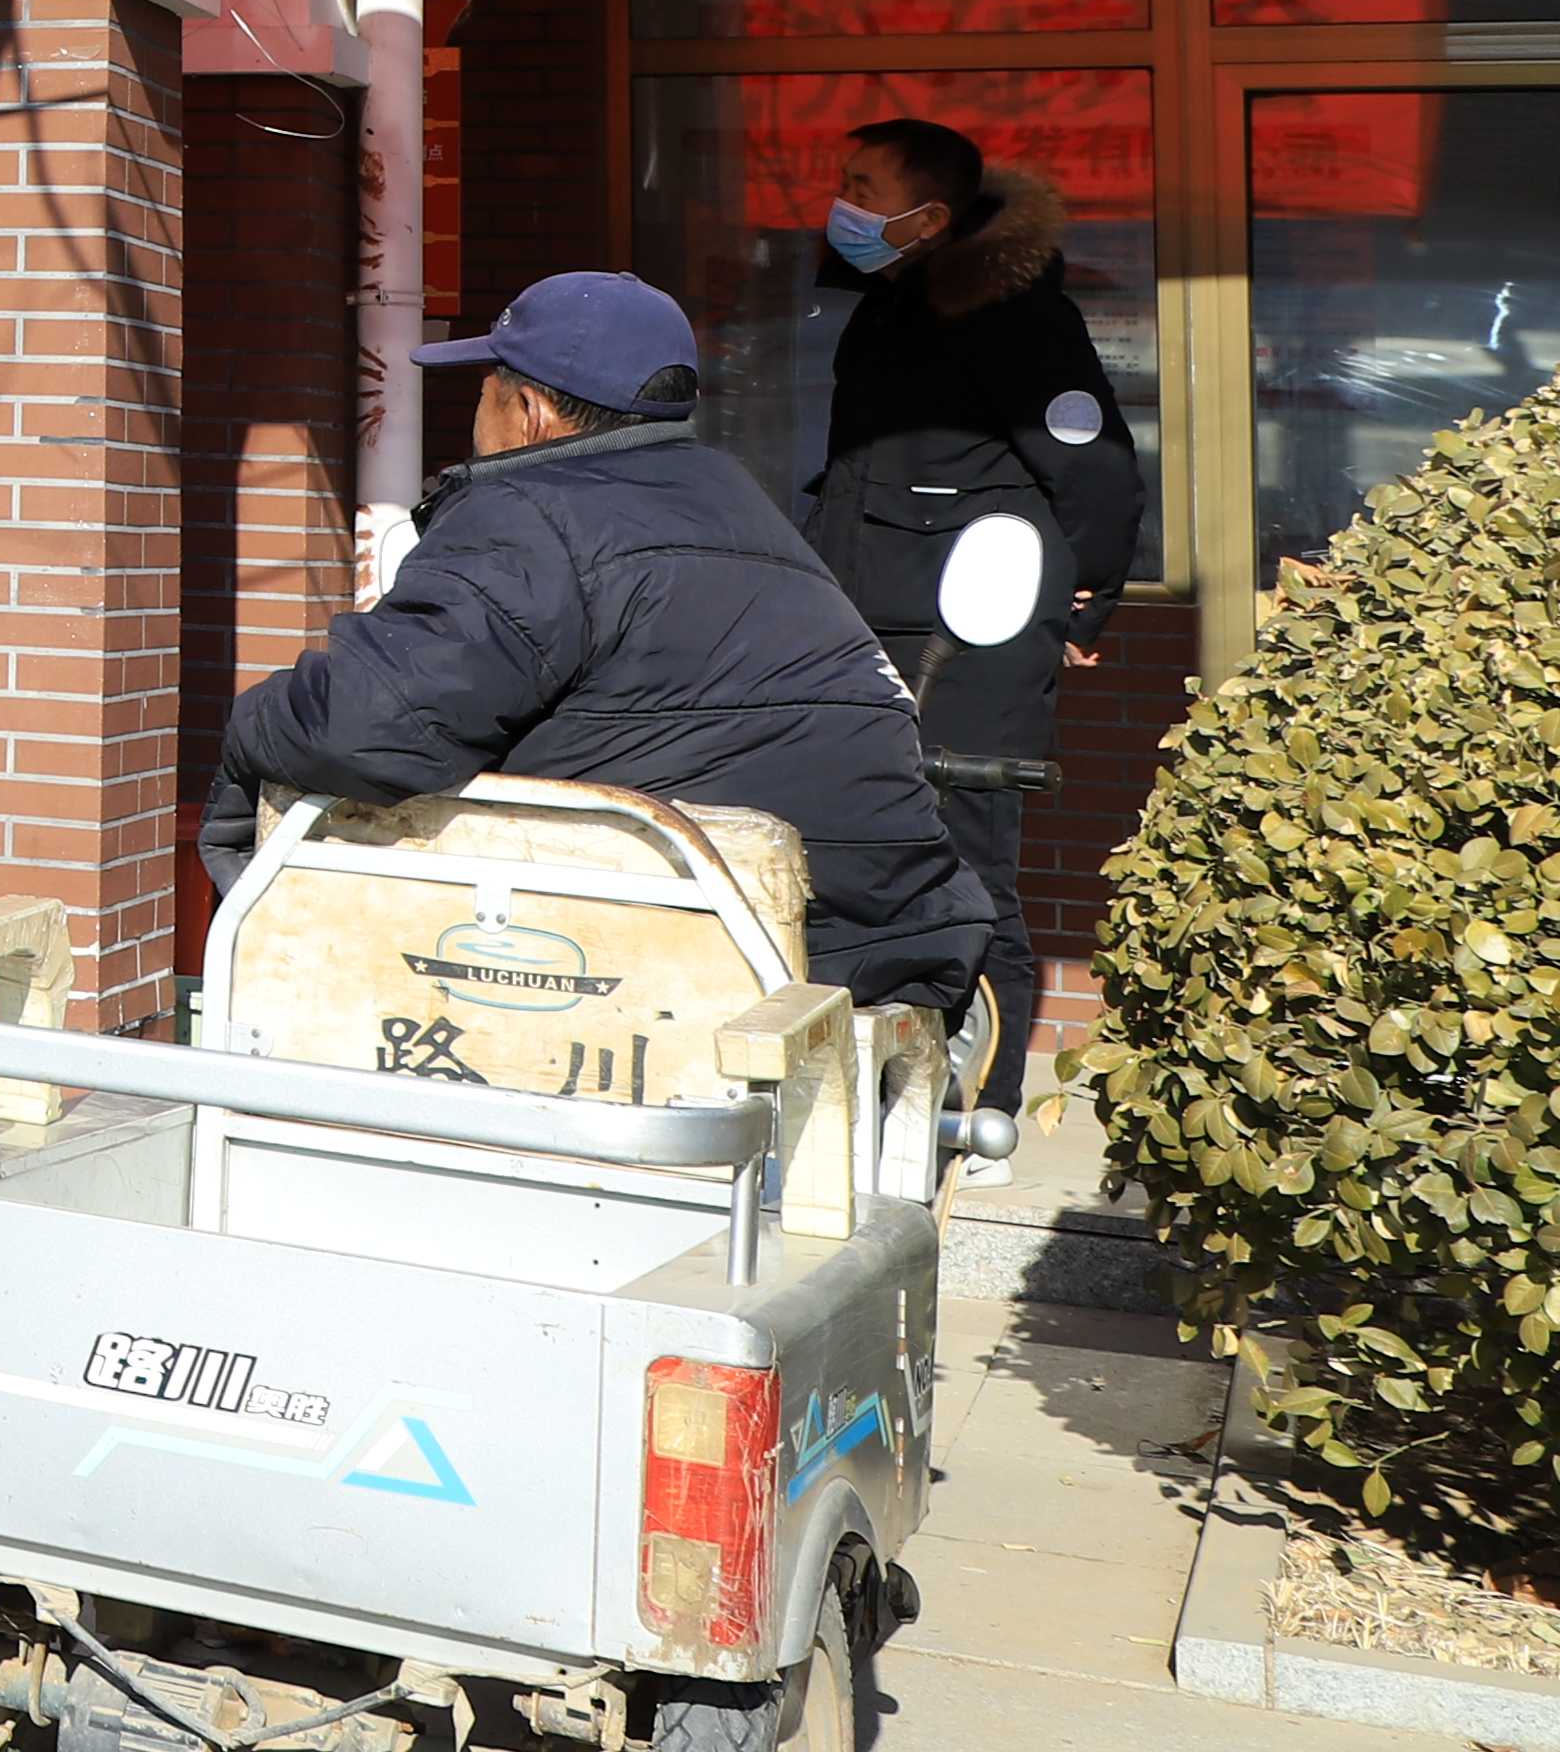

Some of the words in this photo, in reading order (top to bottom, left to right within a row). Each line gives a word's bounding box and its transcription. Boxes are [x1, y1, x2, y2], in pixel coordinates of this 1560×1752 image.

[466, 966, 576, 993] LUCHUAN
[375, 1015, 650, 1105] 路川
[83, 1330, 258, 1414] 路川
